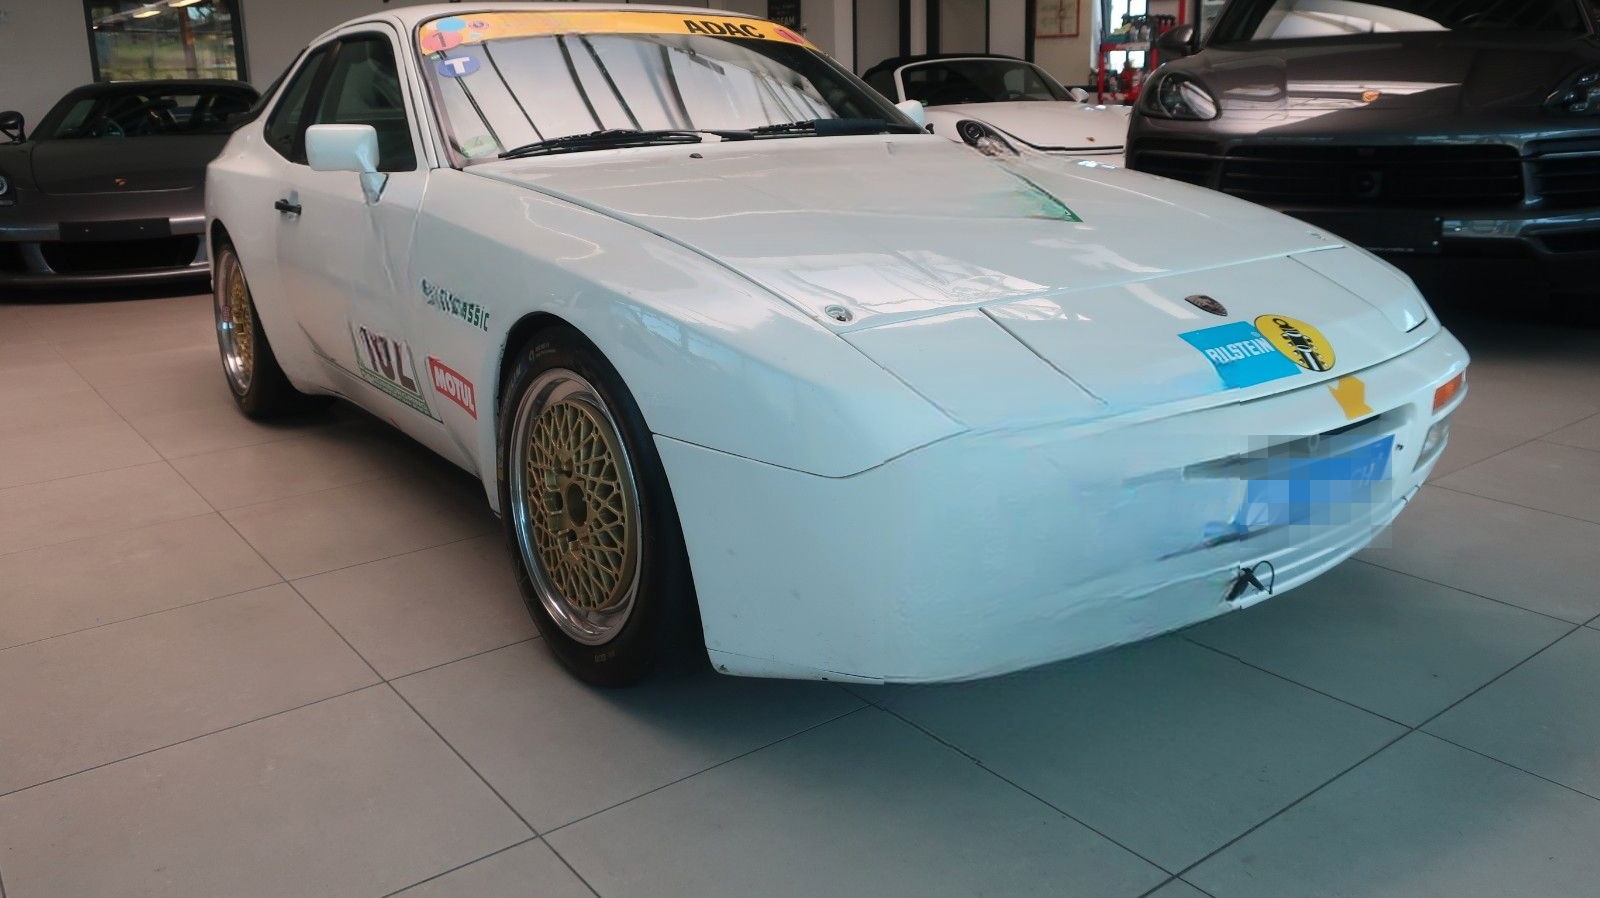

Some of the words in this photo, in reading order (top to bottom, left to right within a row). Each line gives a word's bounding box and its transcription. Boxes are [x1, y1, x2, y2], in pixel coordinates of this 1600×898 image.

[683, 20, 765, 38] ADAC
[444, 57, 470, 74] T
[433, 365, 475, 412] MOTUL
